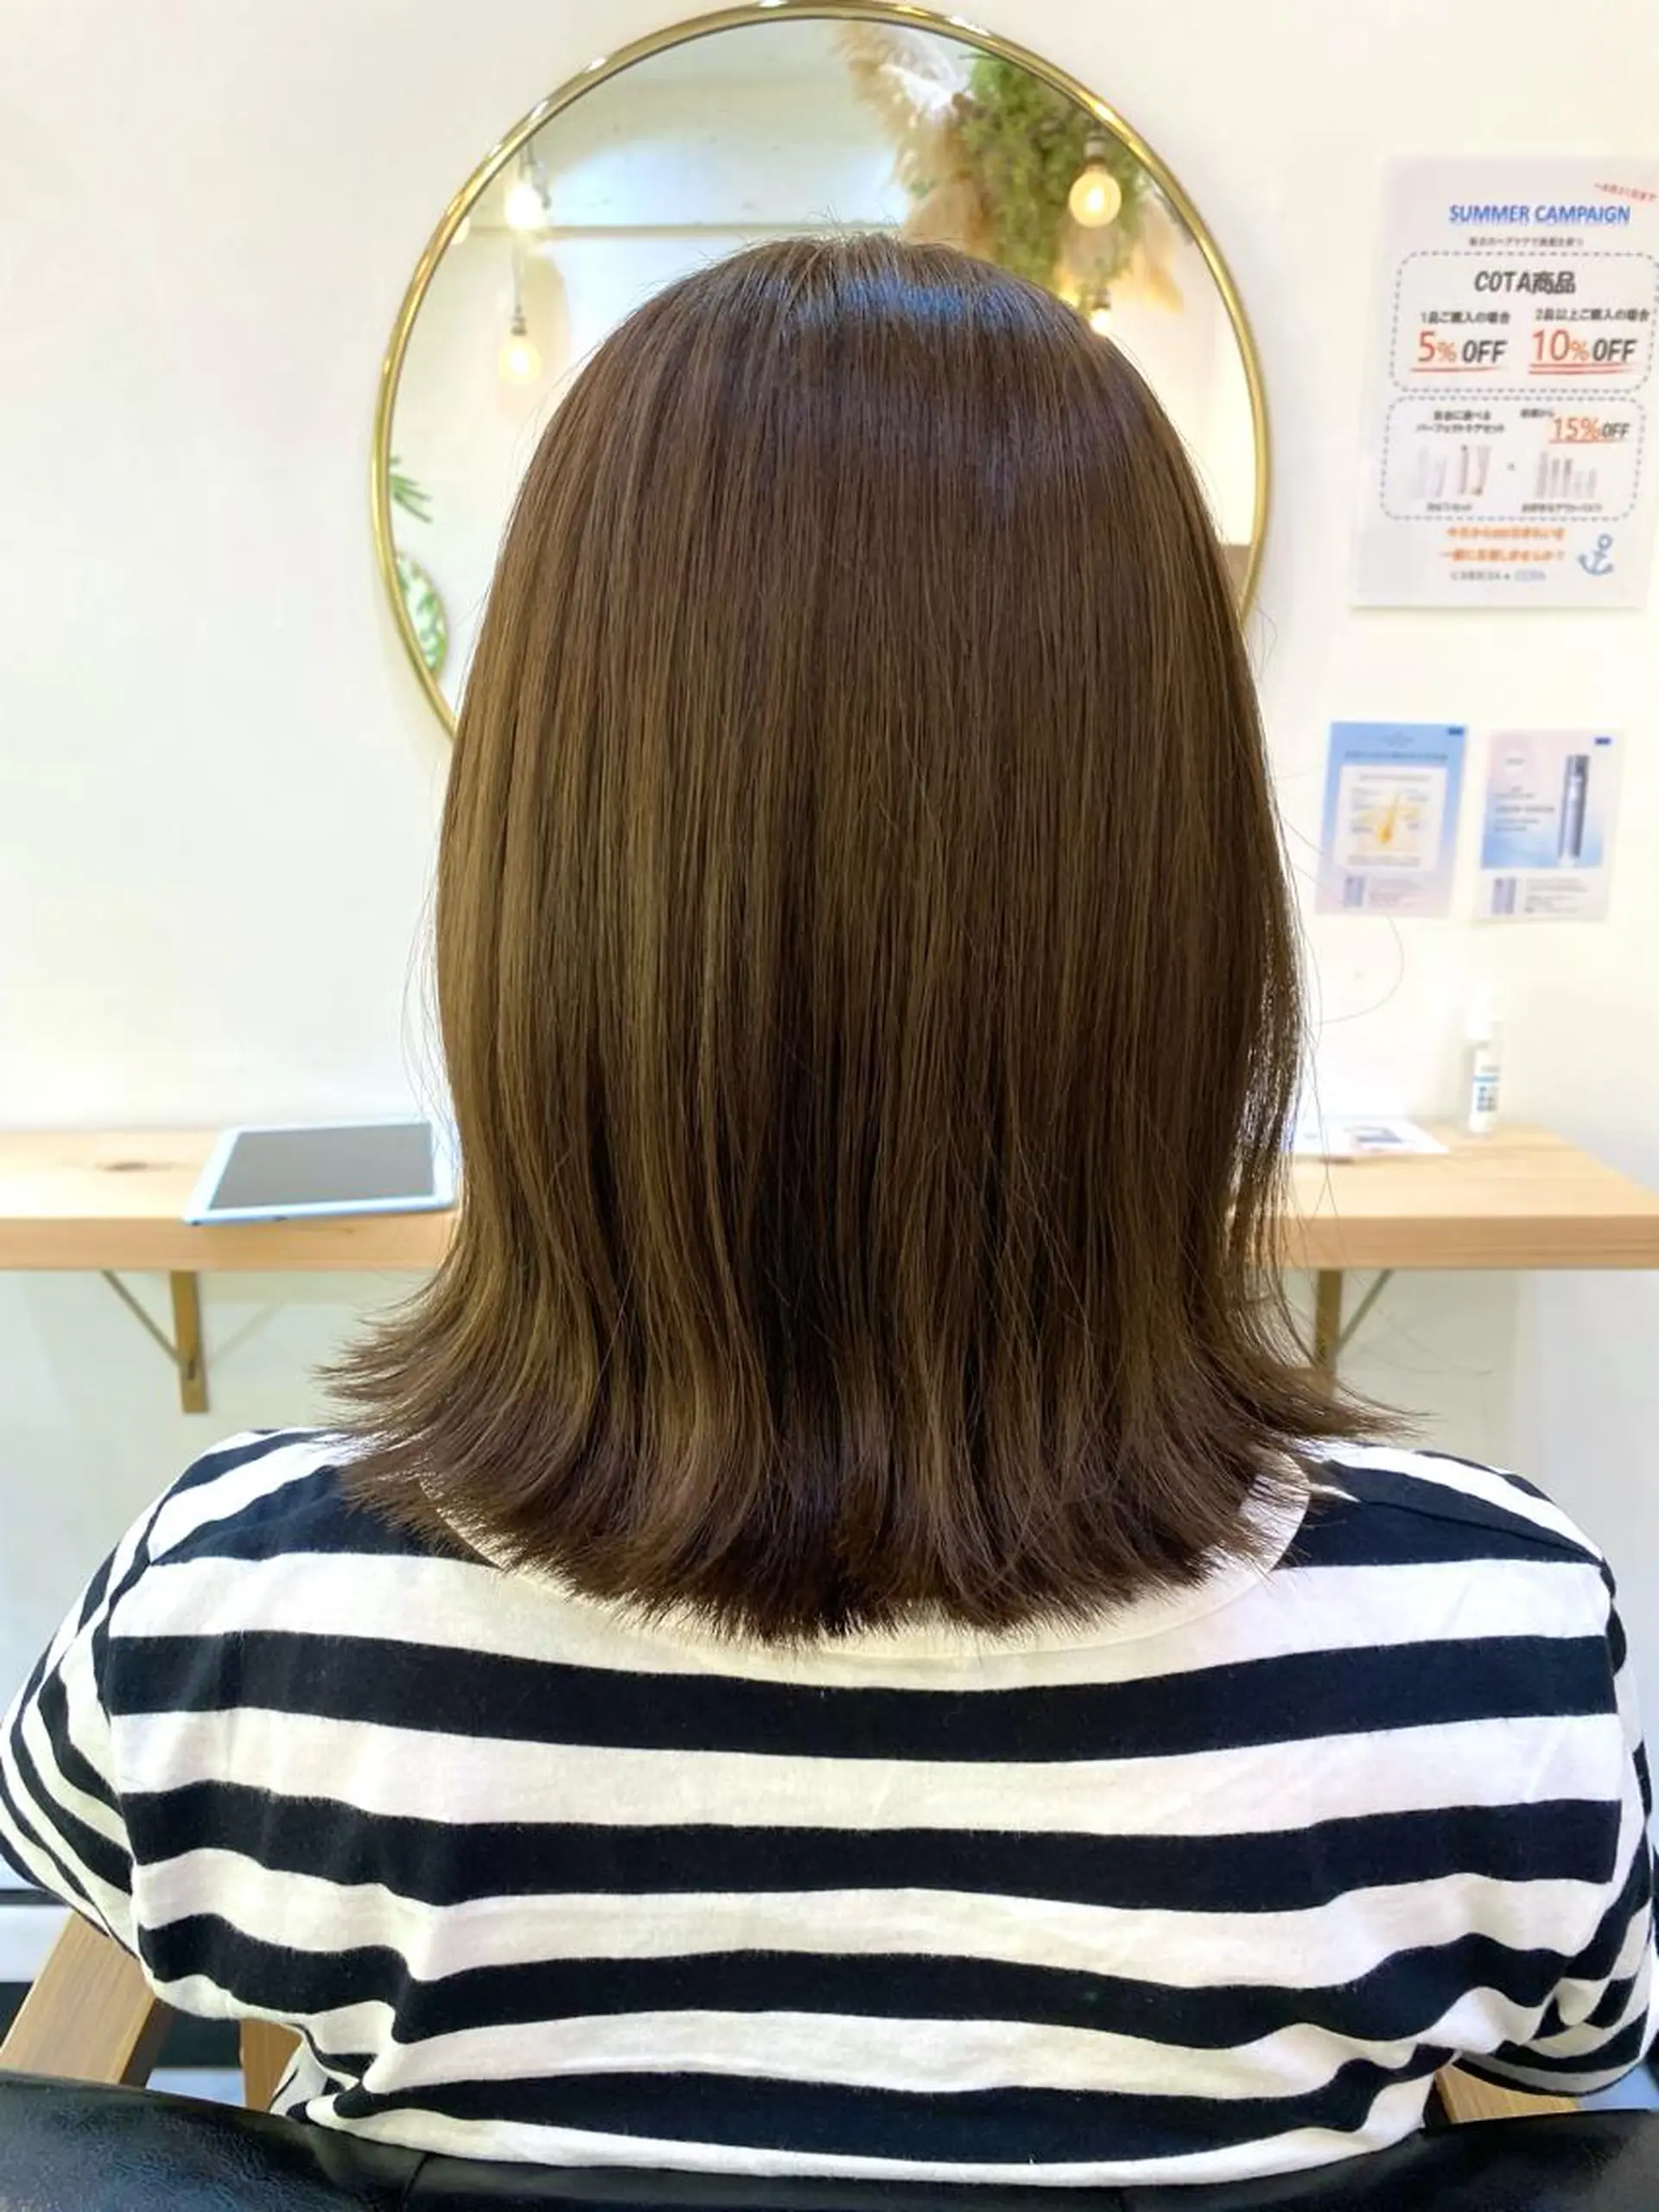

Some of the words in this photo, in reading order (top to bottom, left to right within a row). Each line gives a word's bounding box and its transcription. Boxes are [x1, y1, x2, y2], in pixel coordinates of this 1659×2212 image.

[1449, 204, 1529, 222] SUMMER
[1535, 205, 1630, 224] CAMPAIGN
[1473, 270, 1575, 295] COTA商品
[1462, 340, 1508, 363] OFF
[1532, 329, 1590, 361] 10%
[1592, 338, 1637, 362] OFF
[1602, 422, 1630, 439] OFF
